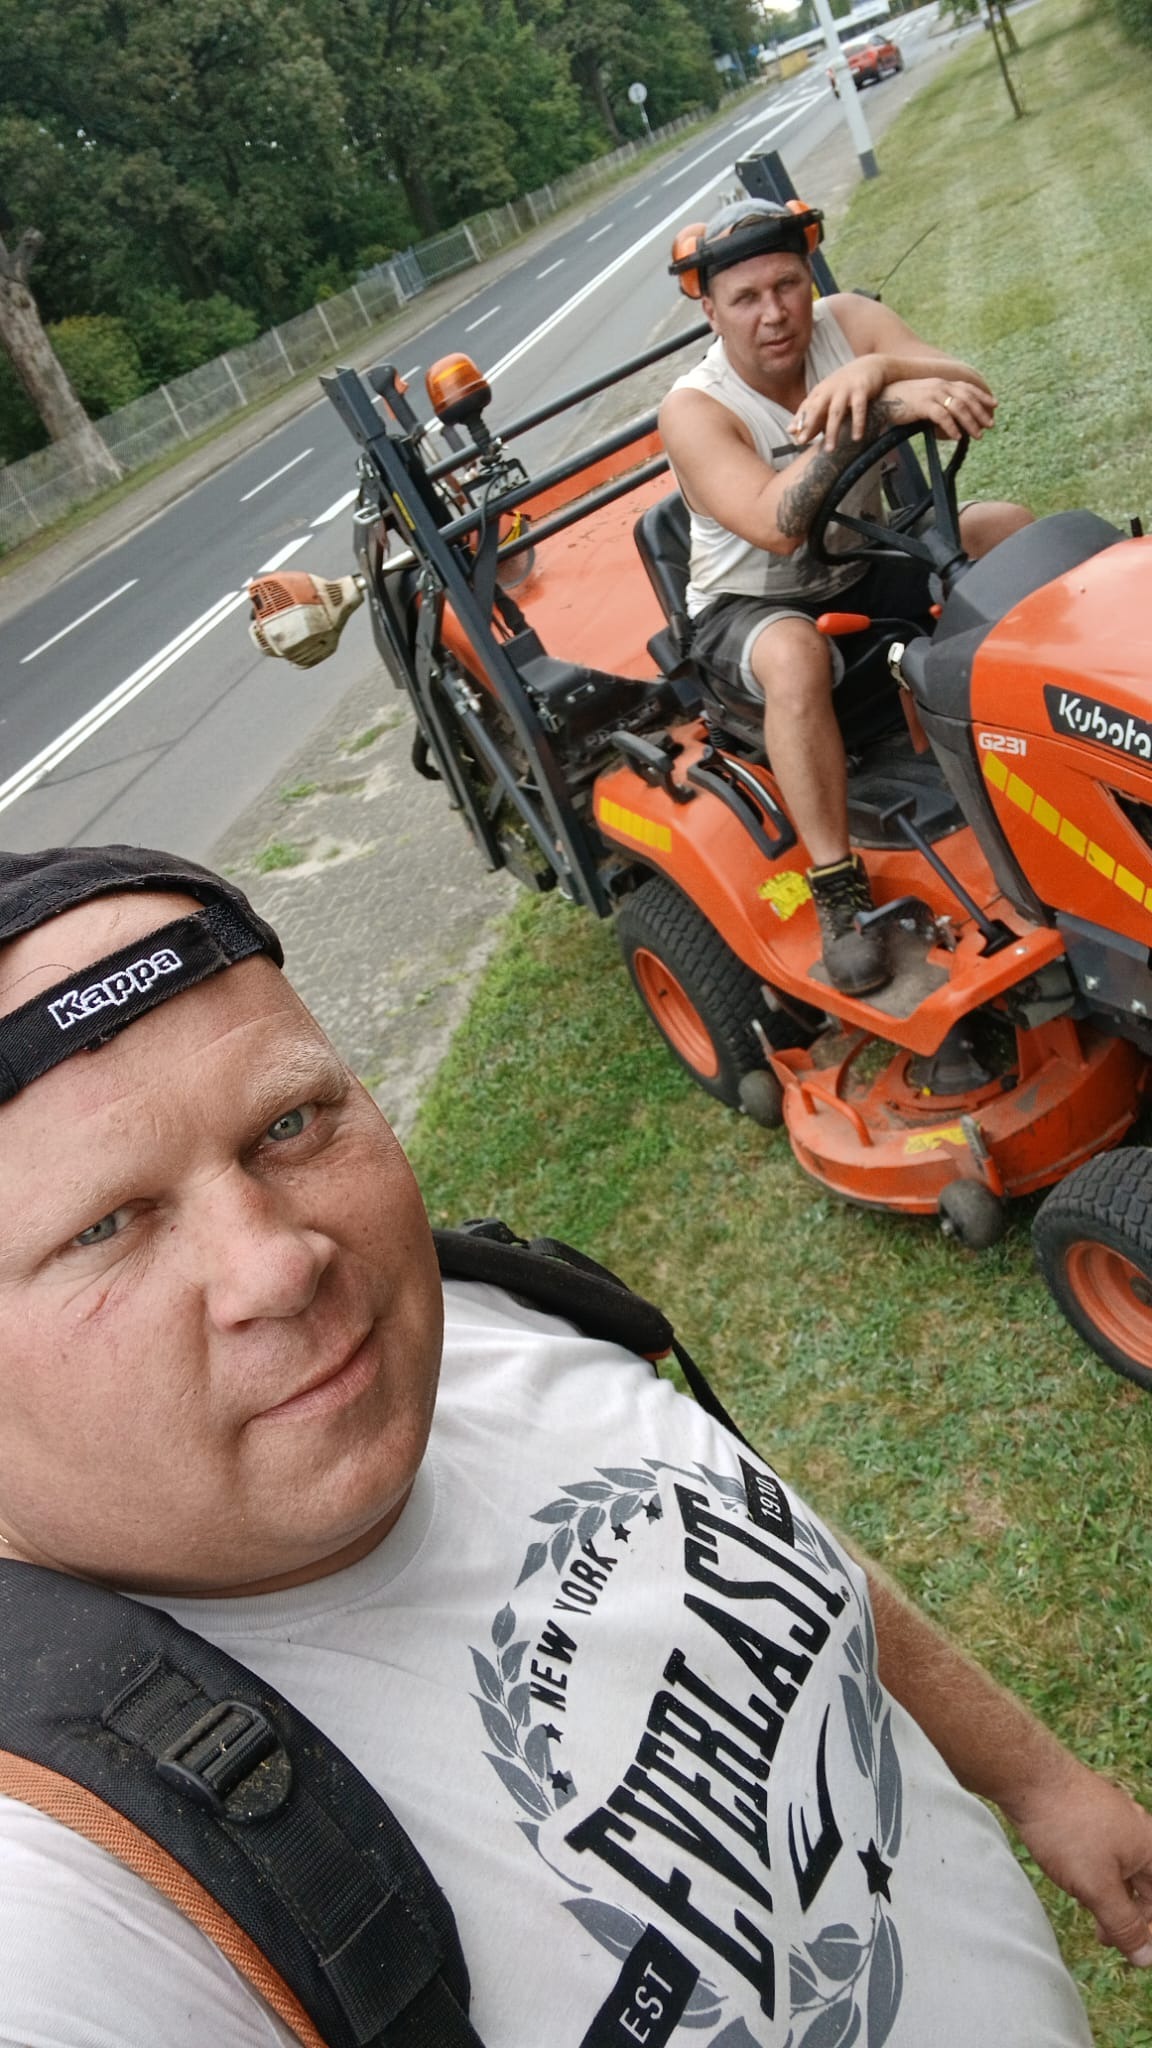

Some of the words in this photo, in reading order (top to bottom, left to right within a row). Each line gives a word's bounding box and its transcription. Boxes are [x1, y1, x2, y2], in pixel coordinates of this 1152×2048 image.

[979, 732, 1026, 757] G231
[1059, 693, 1151, 758] Kubota
[48, 949, 182, 1030] Kappa
[755, 1476, 783, 1522] 1910
[552, 1538, 618, 1616] YORK
[529, 1619, 577, 1713] NEW
[564, 1483, 846, 2021] EVERLAST
[619, 1961, 673, 2044] EST
